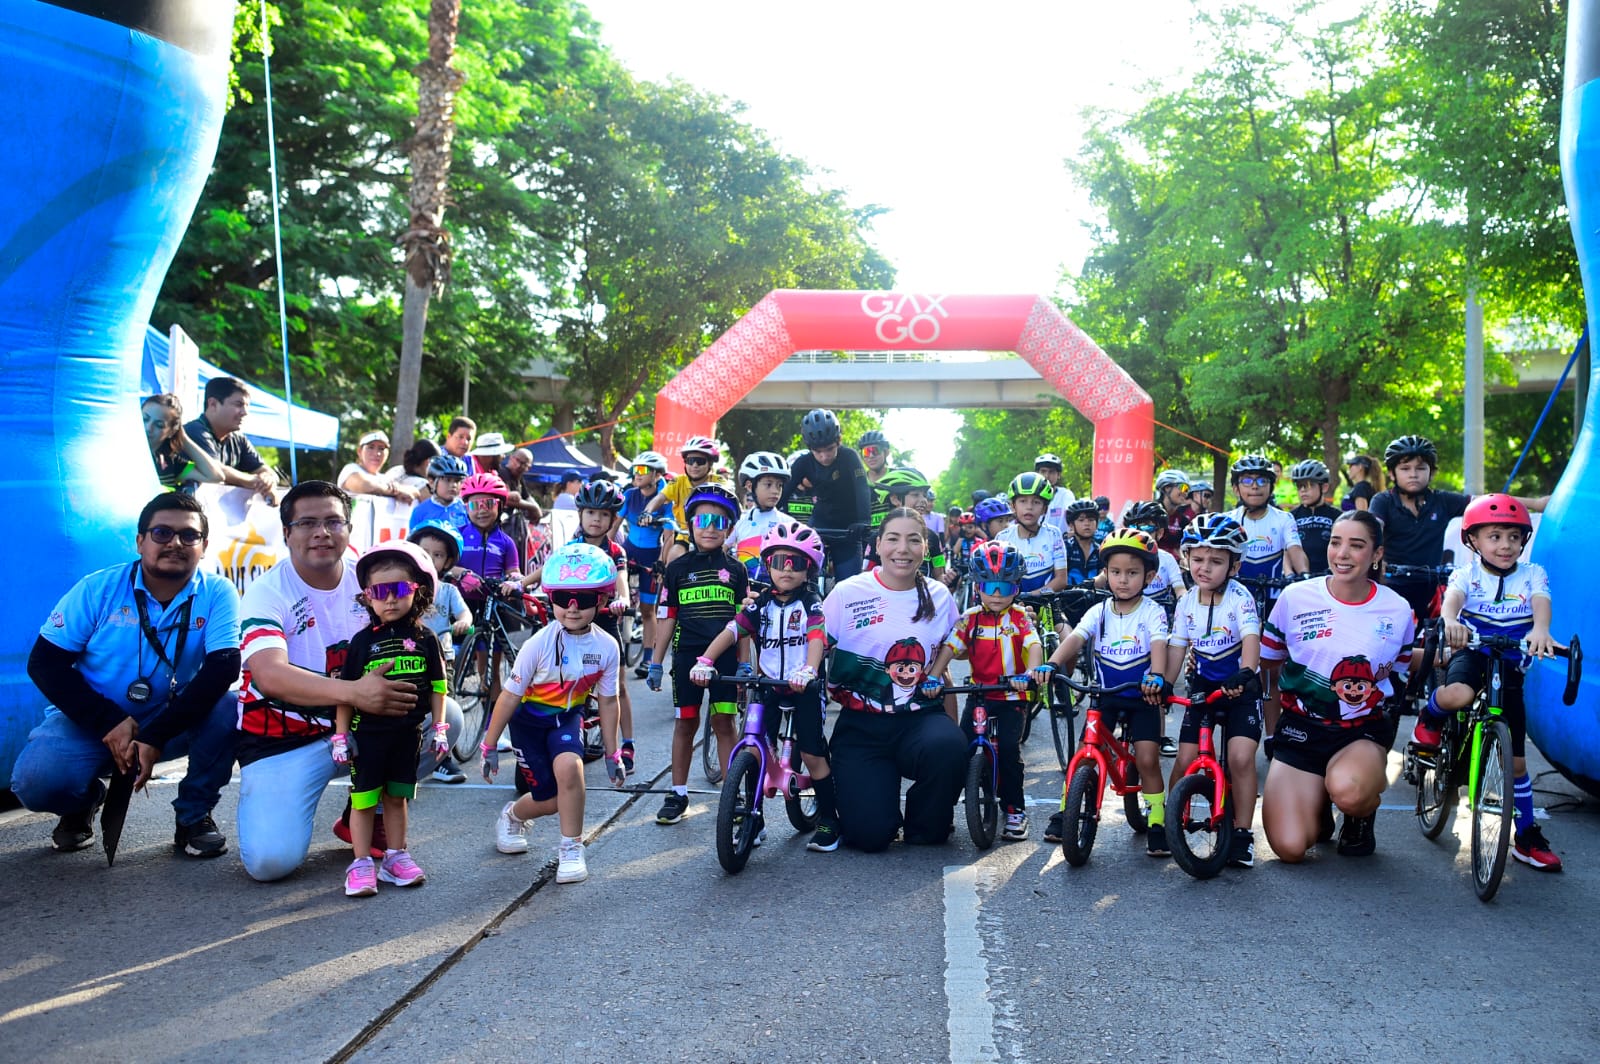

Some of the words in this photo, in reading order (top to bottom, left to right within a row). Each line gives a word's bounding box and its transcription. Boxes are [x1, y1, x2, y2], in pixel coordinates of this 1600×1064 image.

[876, 314, 941, 344] GO
[1098, 452, 1133, 463] CLUB
[1478, 603, 1530, 614] Electrolit
[856, 614, 884, 629] 2026
[1303, 628, 1333, 641] 2026
[1101, 646, 1144, 656] Electrolit
